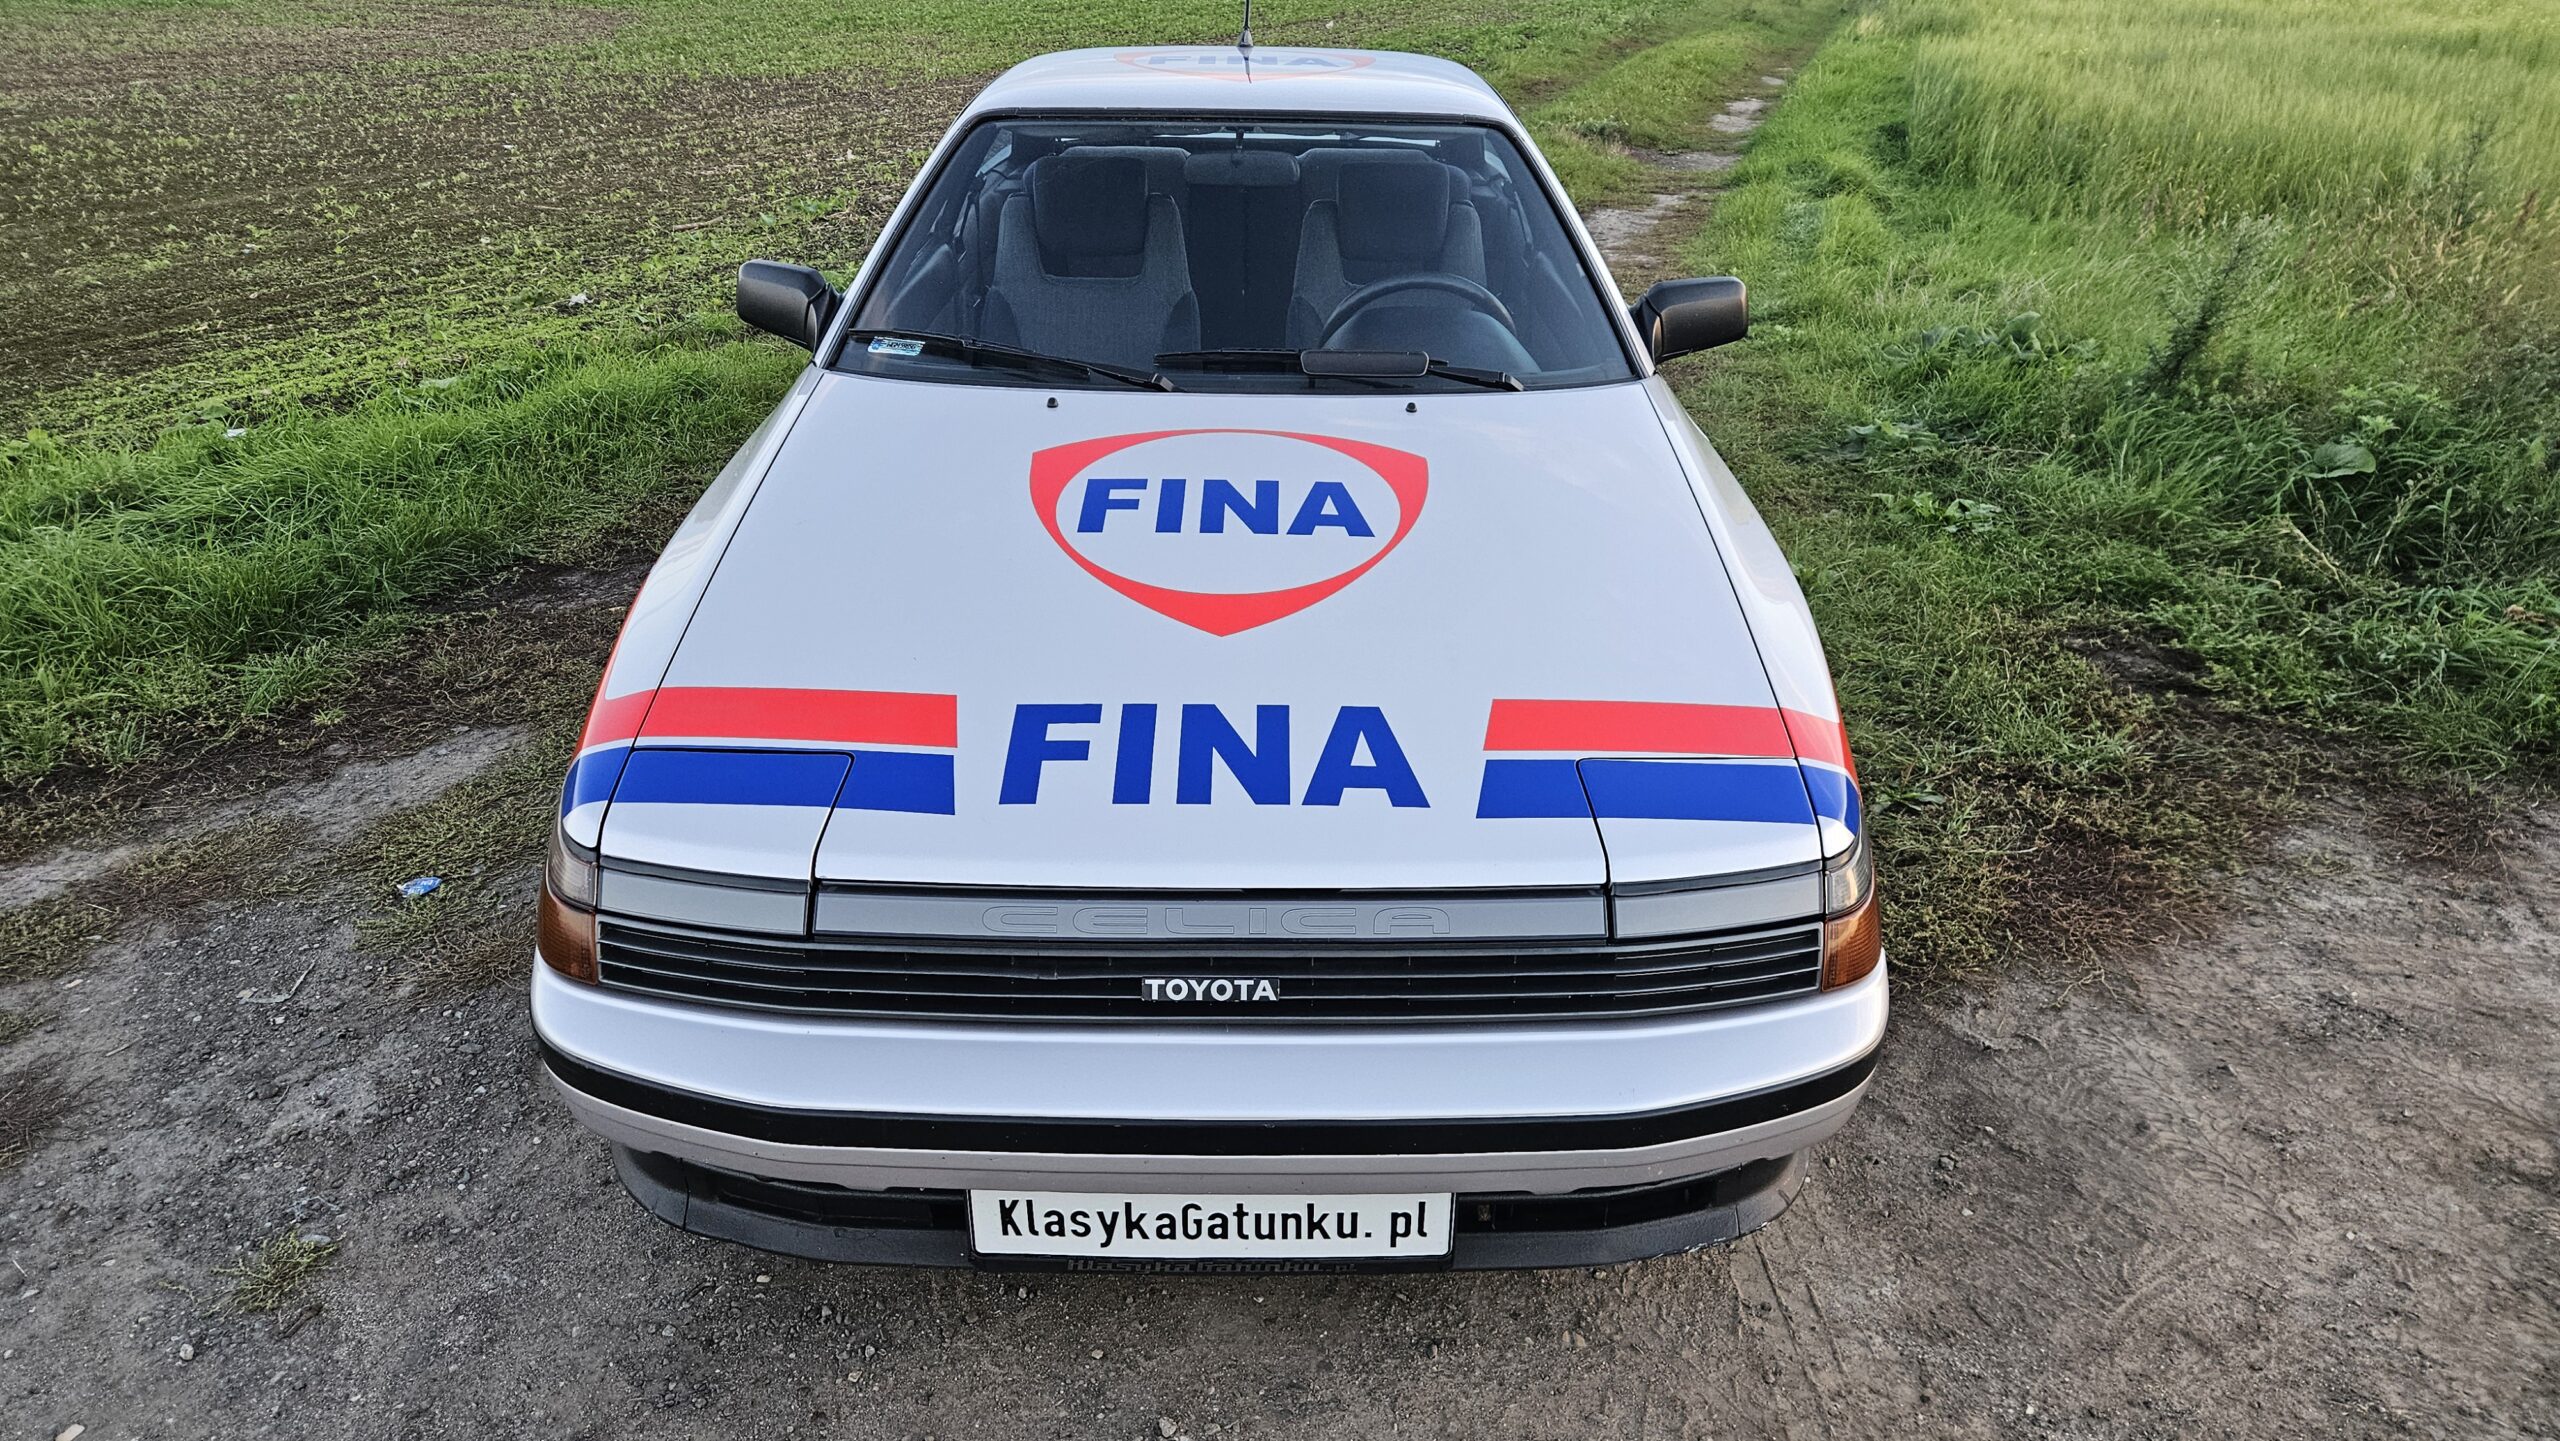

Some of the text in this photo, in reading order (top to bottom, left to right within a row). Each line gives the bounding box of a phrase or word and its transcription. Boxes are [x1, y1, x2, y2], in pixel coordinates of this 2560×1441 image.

[1148, 56, 1341, 67] FINA
[1077, 478, 1376, 538] FINA
[998, 703, 1431, 808] FINA
[982, 906, 1451, 935] CELICA
[1145, 979, 1277, 1001] TOYOTA
